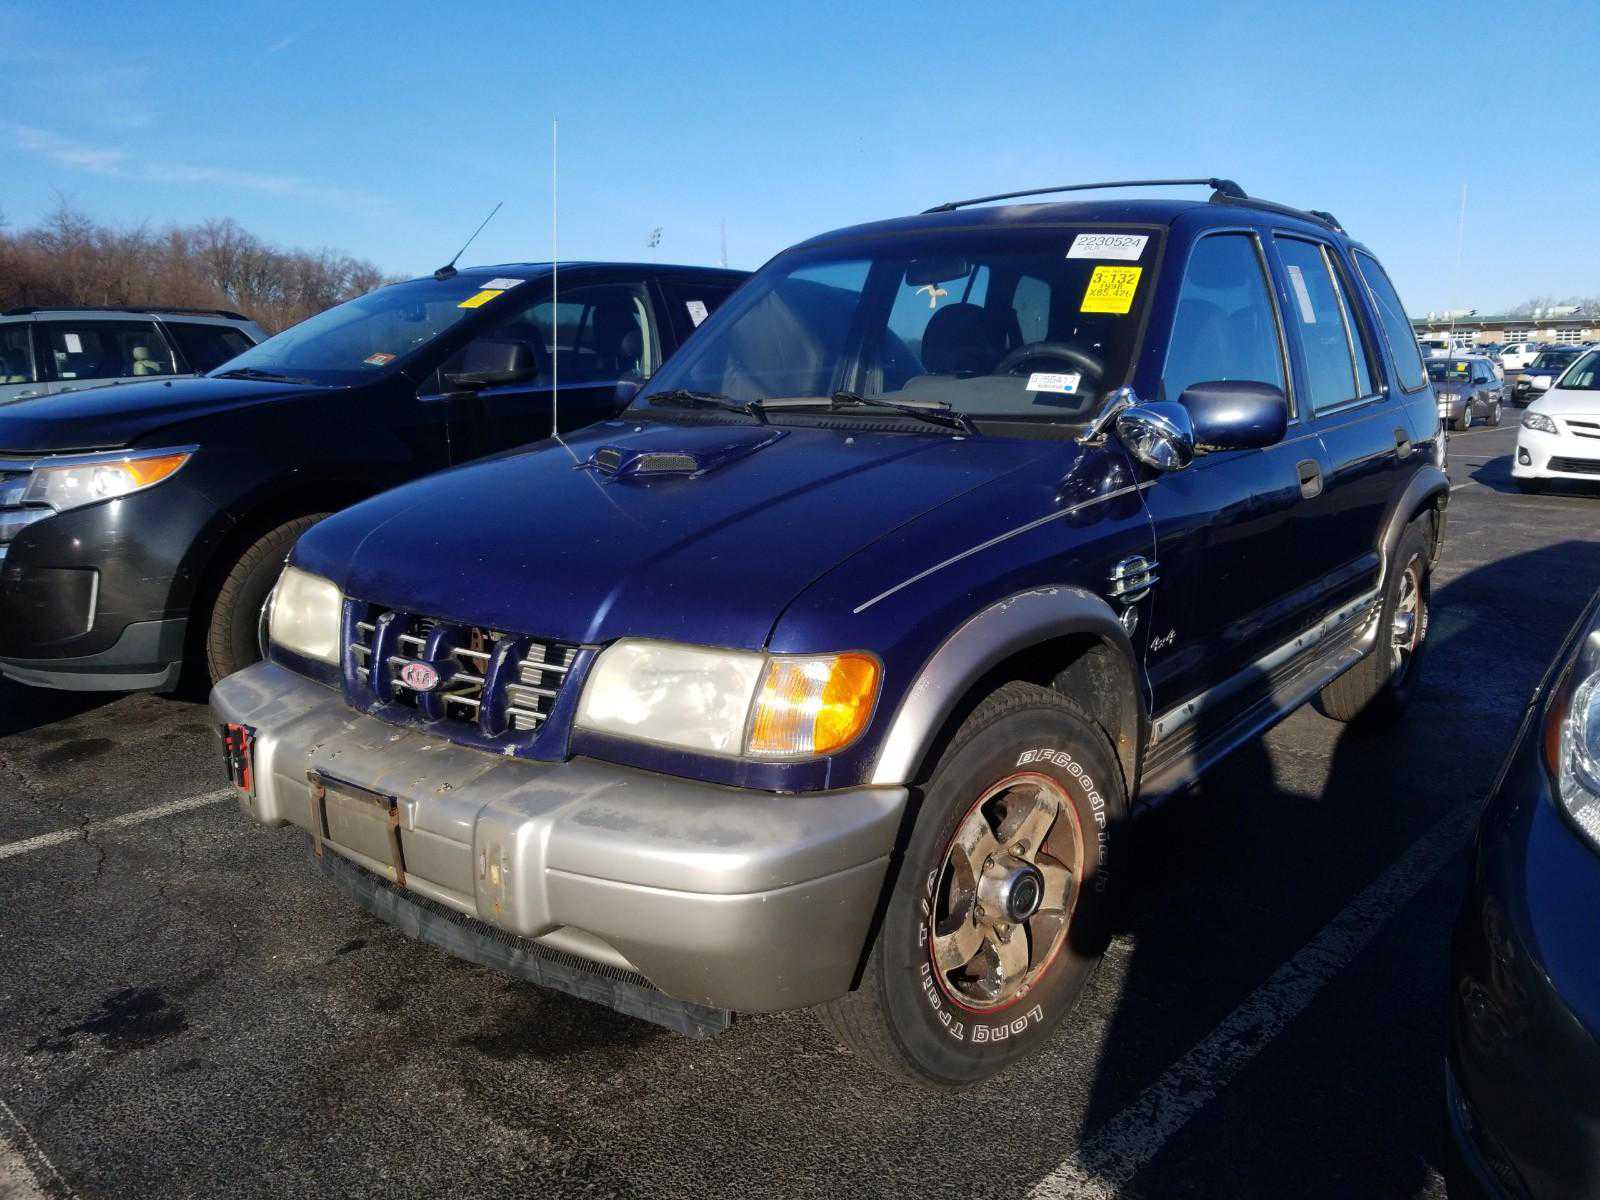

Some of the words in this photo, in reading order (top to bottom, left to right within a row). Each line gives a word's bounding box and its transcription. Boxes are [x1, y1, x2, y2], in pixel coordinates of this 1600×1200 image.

[1077, 236, 1142, 248] 2230524
[920, 961, 964, 1041] Trail
[971, 1003, 1044, 1043] Long
